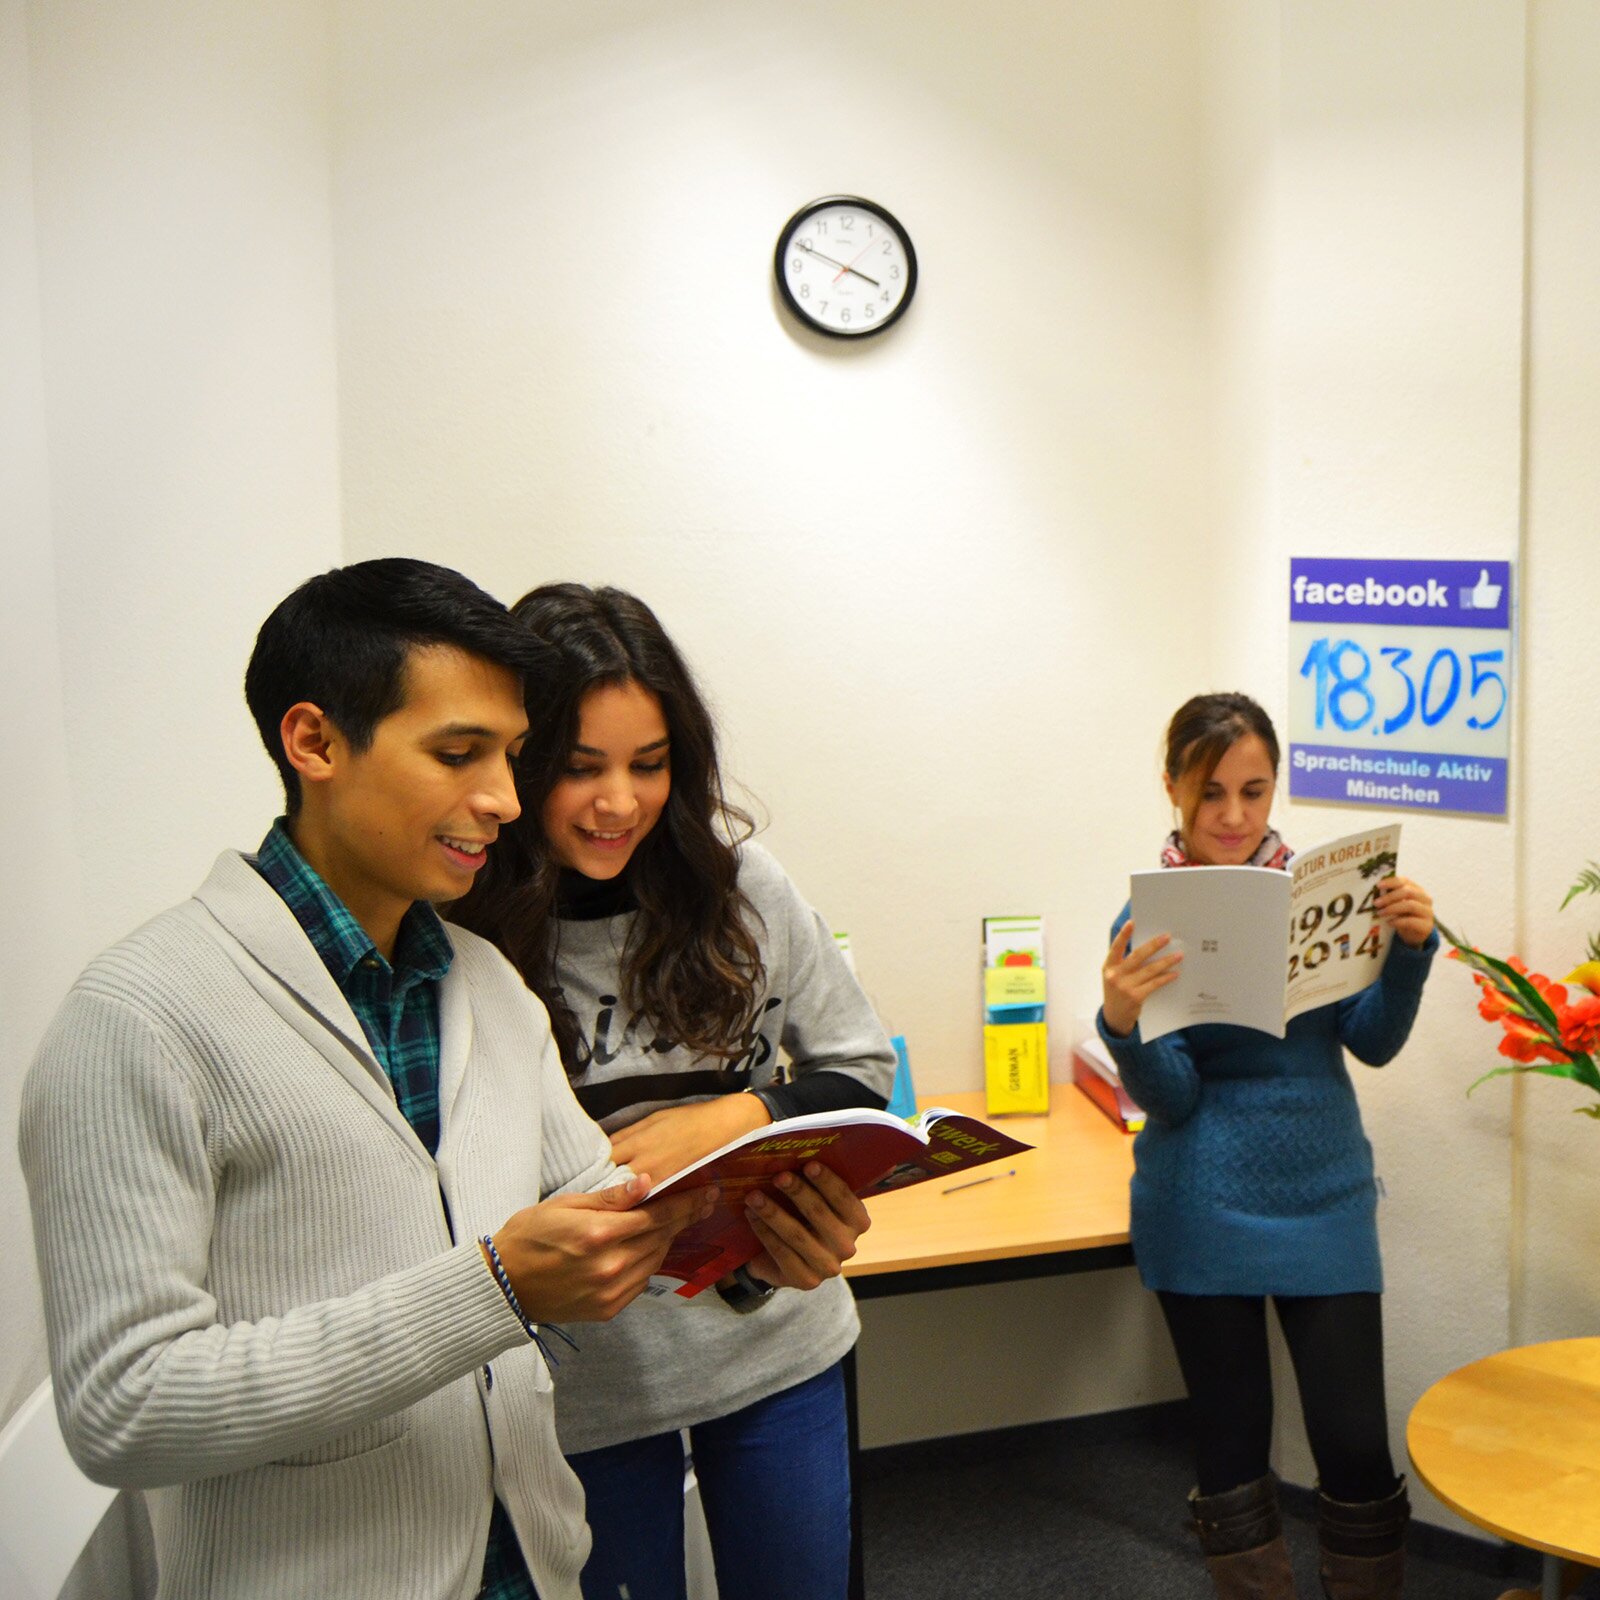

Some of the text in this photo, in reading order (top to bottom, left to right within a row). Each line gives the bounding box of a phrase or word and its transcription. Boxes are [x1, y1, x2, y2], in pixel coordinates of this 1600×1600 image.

[816, 221, 828, 235] 11
[840, 215, 854, 230] 12
[867, 224, 874, 238] 1
[800, 238, 813, 252] 10
[882, 240, 893, 255] 2
[792, 259, 802, 273] 9
[889, 264, 900, 279] 3
[800, 284, 810, 299] 8
[880, 290, 890, 303] 4
[819, 301, 829, 315] 7
[841, 308, 851, 323] 6
[865, 304, 875, 318] 5
[1293, 575, 1449, 608] facebook
[1300, 637, 1507, 736] 18.305
[1293, 750, 1493, 782] Sprachschule Aktiv
[1346, 779, 1441, 804] München
[1329, 840, 1372, 866] KOREA
[1290, 885, 1382, 946] 1994
[1288, 924, 1383, 983] 2014
[751, 1132, 841, 1153] Netzwerk
